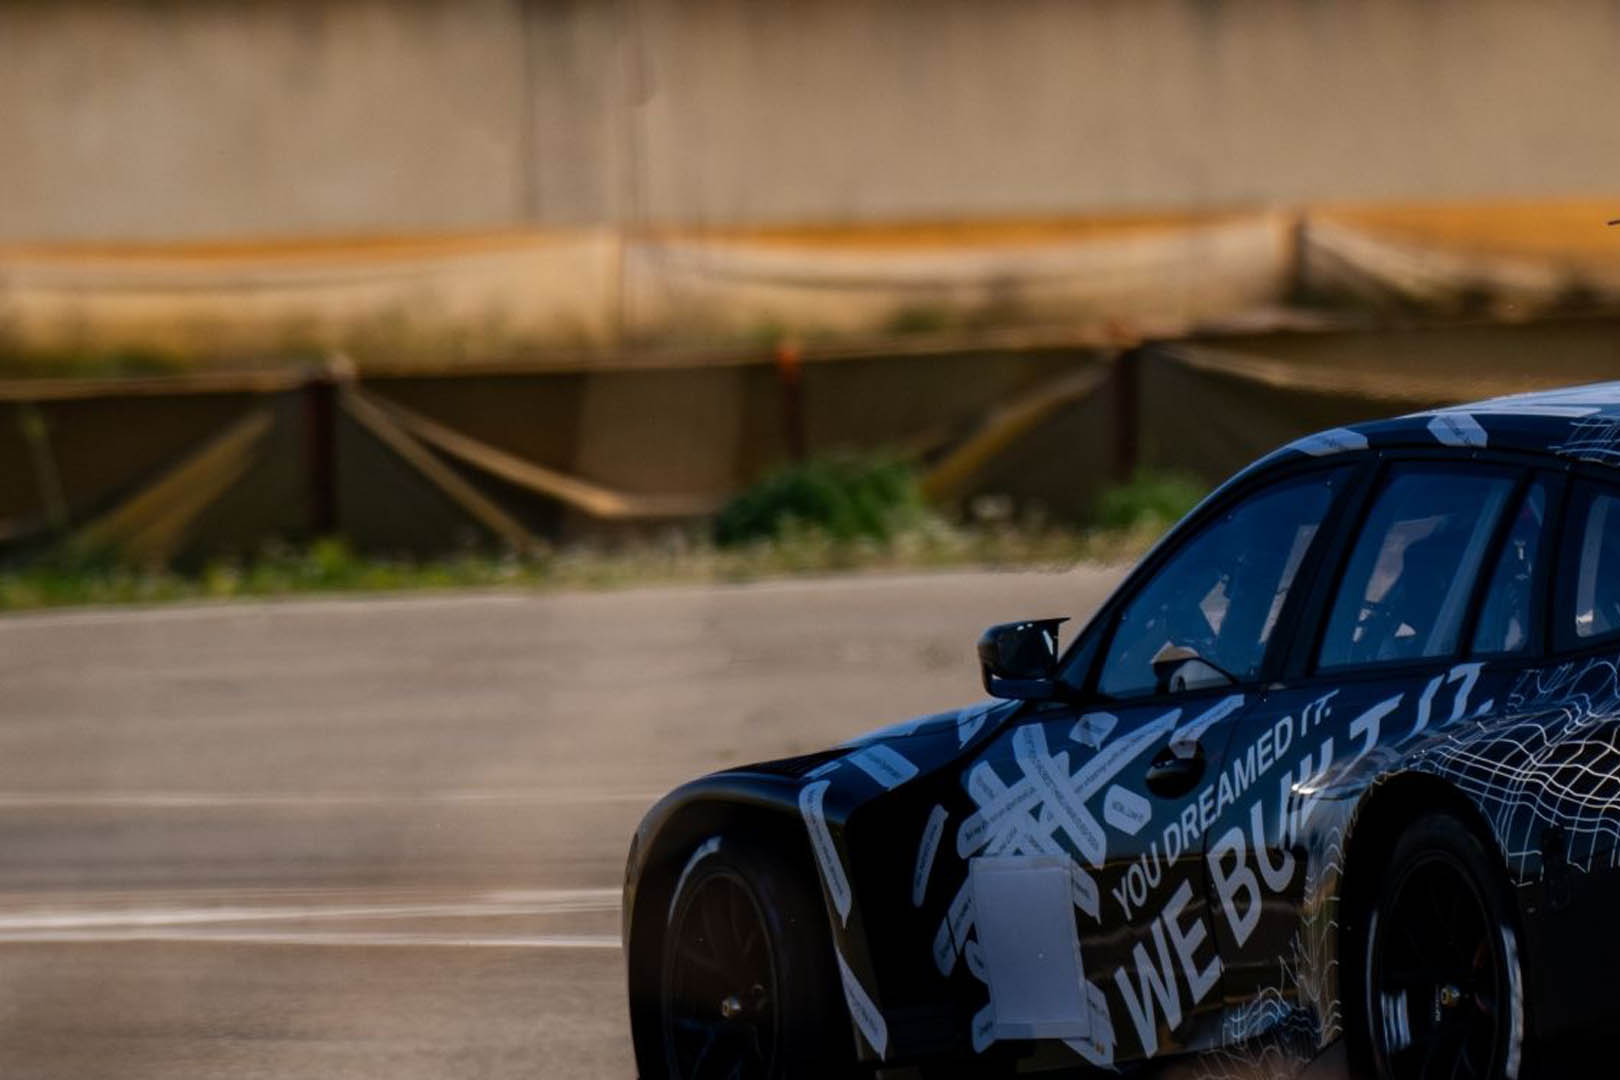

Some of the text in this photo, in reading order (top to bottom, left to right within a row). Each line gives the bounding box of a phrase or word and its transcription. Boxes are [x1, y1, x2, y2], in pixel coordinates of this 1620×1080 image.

[1112, 842, 1161, 921] YOU
[1163, 715, 1292, 863] DREAMED
[1301, 689, 1340, 736] IT.
[1114, 879, 1222, 1059] WE
